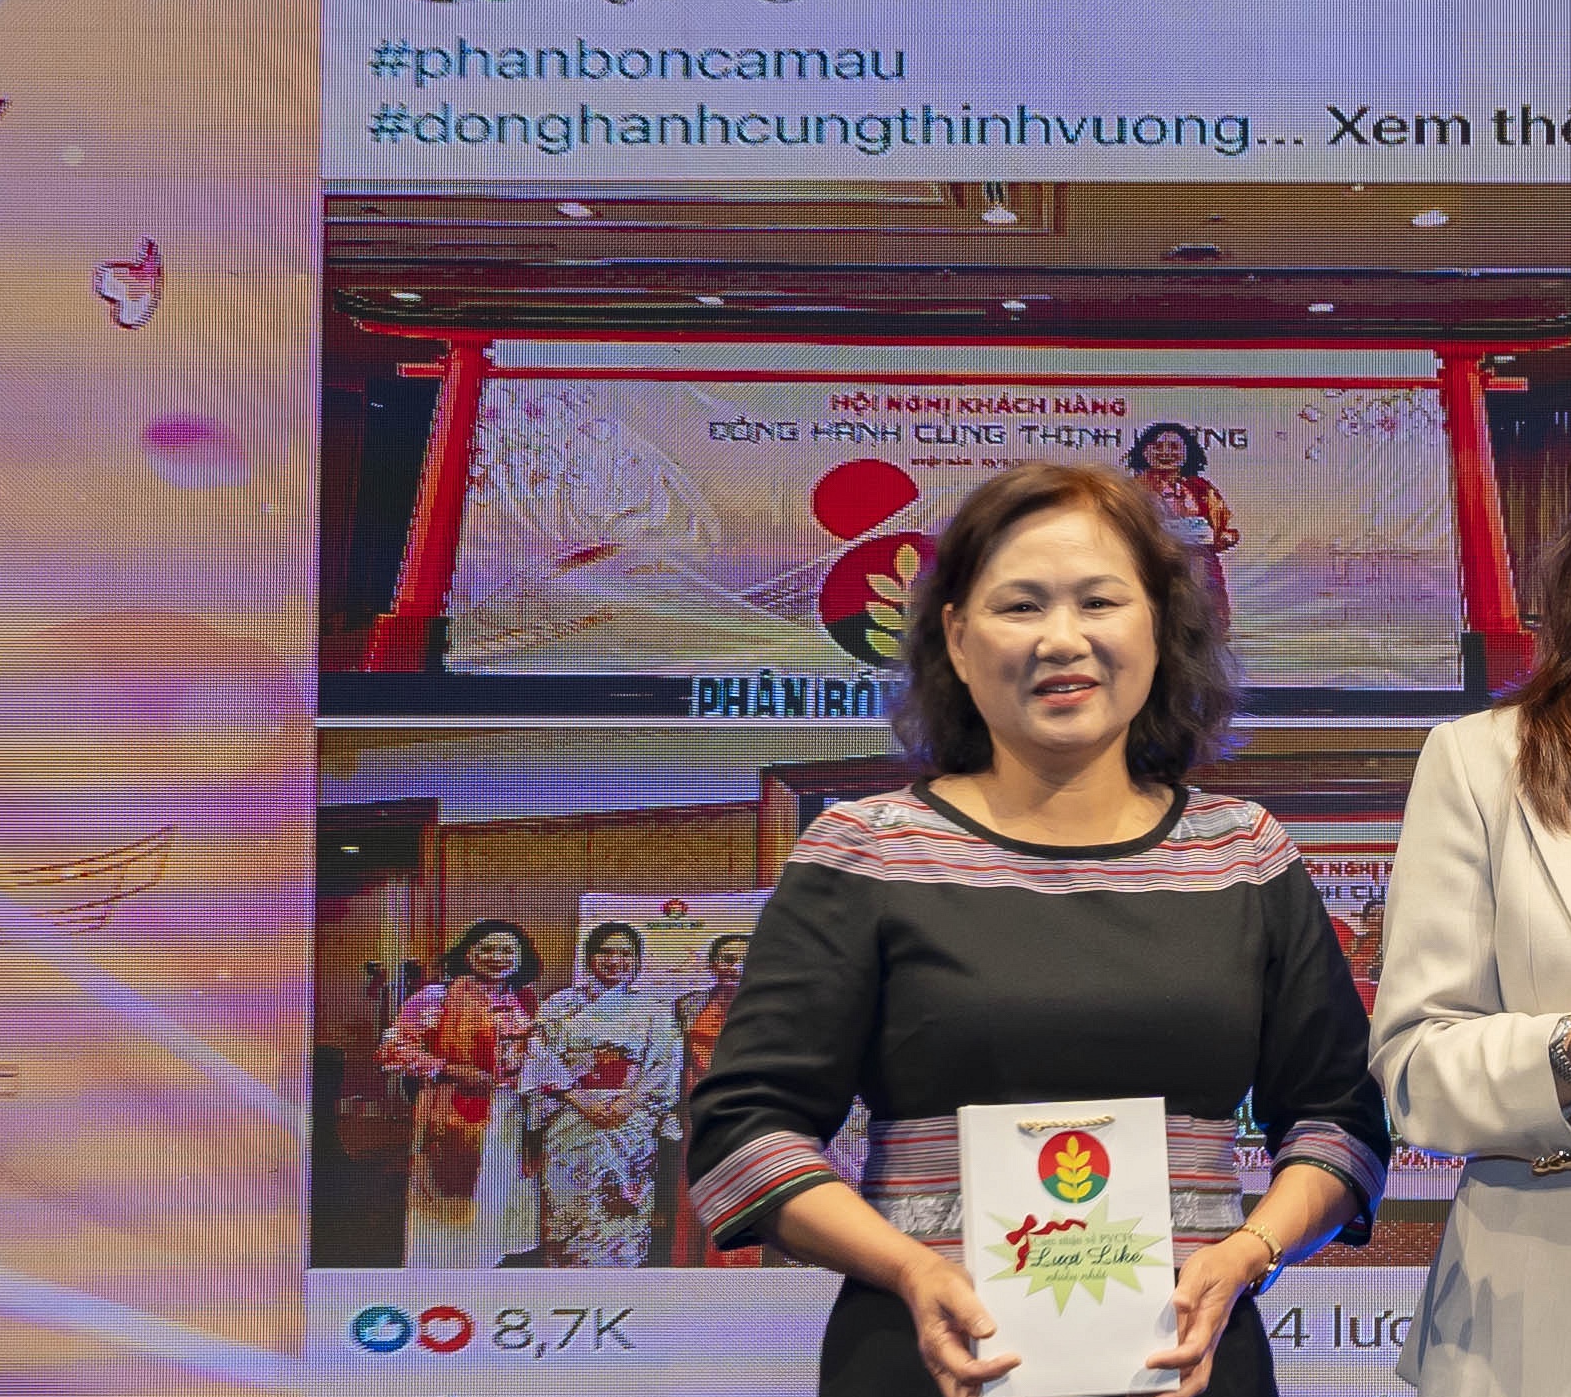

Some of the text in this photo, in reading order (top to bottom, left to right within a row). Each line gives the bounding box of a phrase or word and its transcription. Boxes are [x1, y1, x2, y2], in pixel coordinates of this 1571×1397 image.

[368, 38, 907, 87] #phanboncamau
[1327, 105, 1473, 147] Xem
[1086, 1244, 1144, 1265] Like
[492, 1307, 637, 1359] 8,7K
